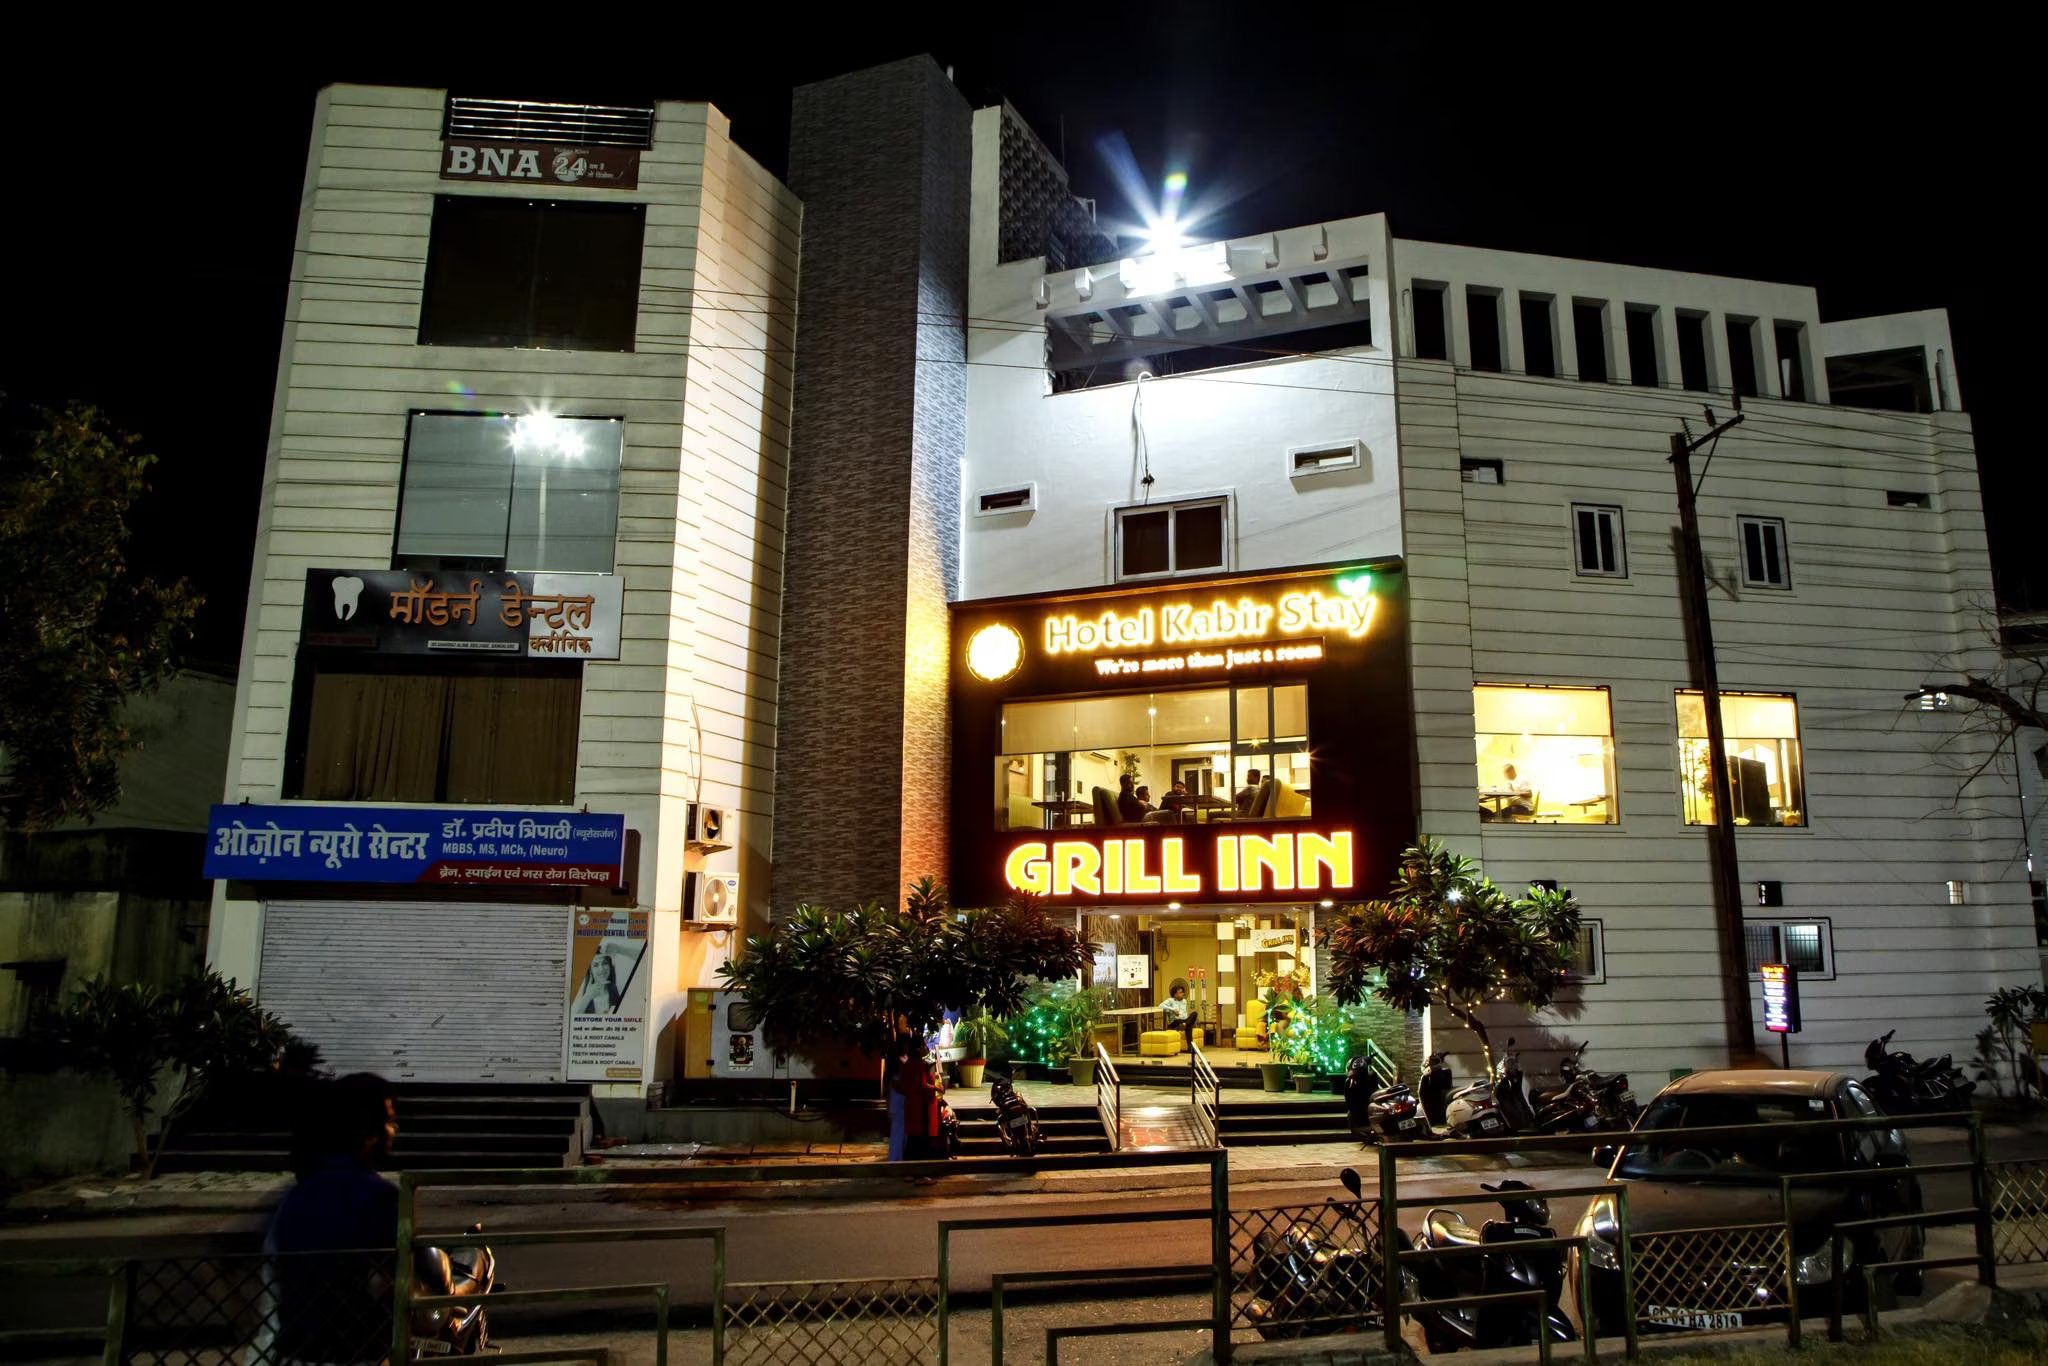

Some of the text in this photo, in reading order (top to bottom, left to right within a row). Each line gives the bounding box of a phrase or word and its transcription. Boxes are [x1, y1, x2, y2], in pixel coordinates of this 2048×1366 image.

[446, 145, 543, 178] BNA
[554, 156, 587, 176] 24
[389, 578, 595, 630] मॉडर्न डेन्टल
[1045, 591, 1376, 654] Hotel Kabir Stay
[529, 630, 593, 654] क्लीनिक
[1095, 645, 1322, 675] We're more than just a room
[442, 818, 467, 839] डॉ.
[472, 817, 516, 840] प्रदीप
[519, 818, 573, 840] त्रिपाठी
[214, 820, 430, 869] ओज़ोन न्यूरो सेन्टर
[442, 842, 568, 858] MBBS, MS, MCh, (Neuro)
[504, 867, 521, 879] एवं
[545, 867, 566, 880] रोग
[1005, 832, 1353, 897] GRILL INN
[1690, 1314, 1706, 1328] HA
